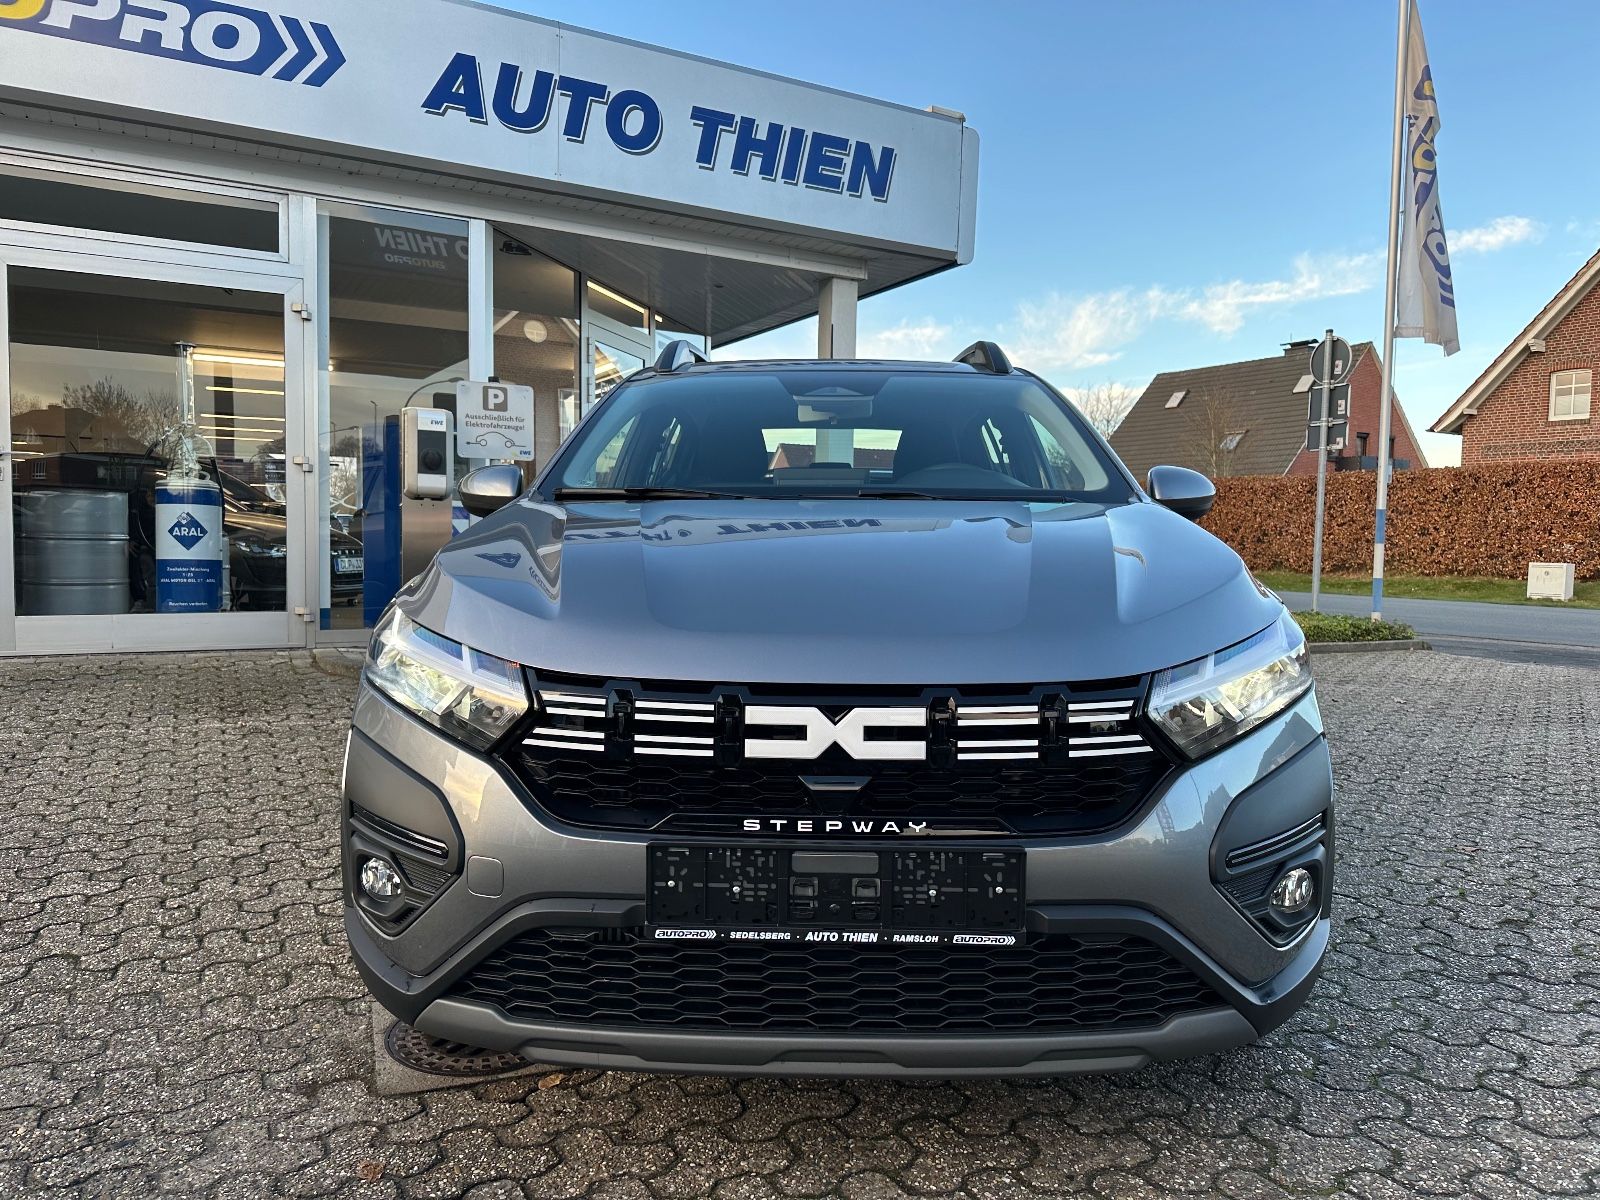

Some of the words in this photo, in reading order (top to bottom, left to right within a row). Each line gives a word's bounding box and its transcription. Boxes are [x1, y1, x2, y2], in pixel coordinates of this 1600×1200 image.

[421, 52, 663, 155] AUTO
[689, 105, 897, 203] THIEN
[487, 388, 505, 410] P
[464, 412, 514, 423] Ausschließlich
[515, 416, 525, 424] für
[465, 420, 525, 432] Elektrofahrzeuge!
[172, 526, 204, 537] ARAL
[743, 819, 927, 833] STEPWAY
[729, 931, 791, 940] SEDELSBERG
[804, 931, 839, 942] AUTO
[842, 932, 878, 943] THIEN
[893, 934, 939, 943] RAMSLOH
